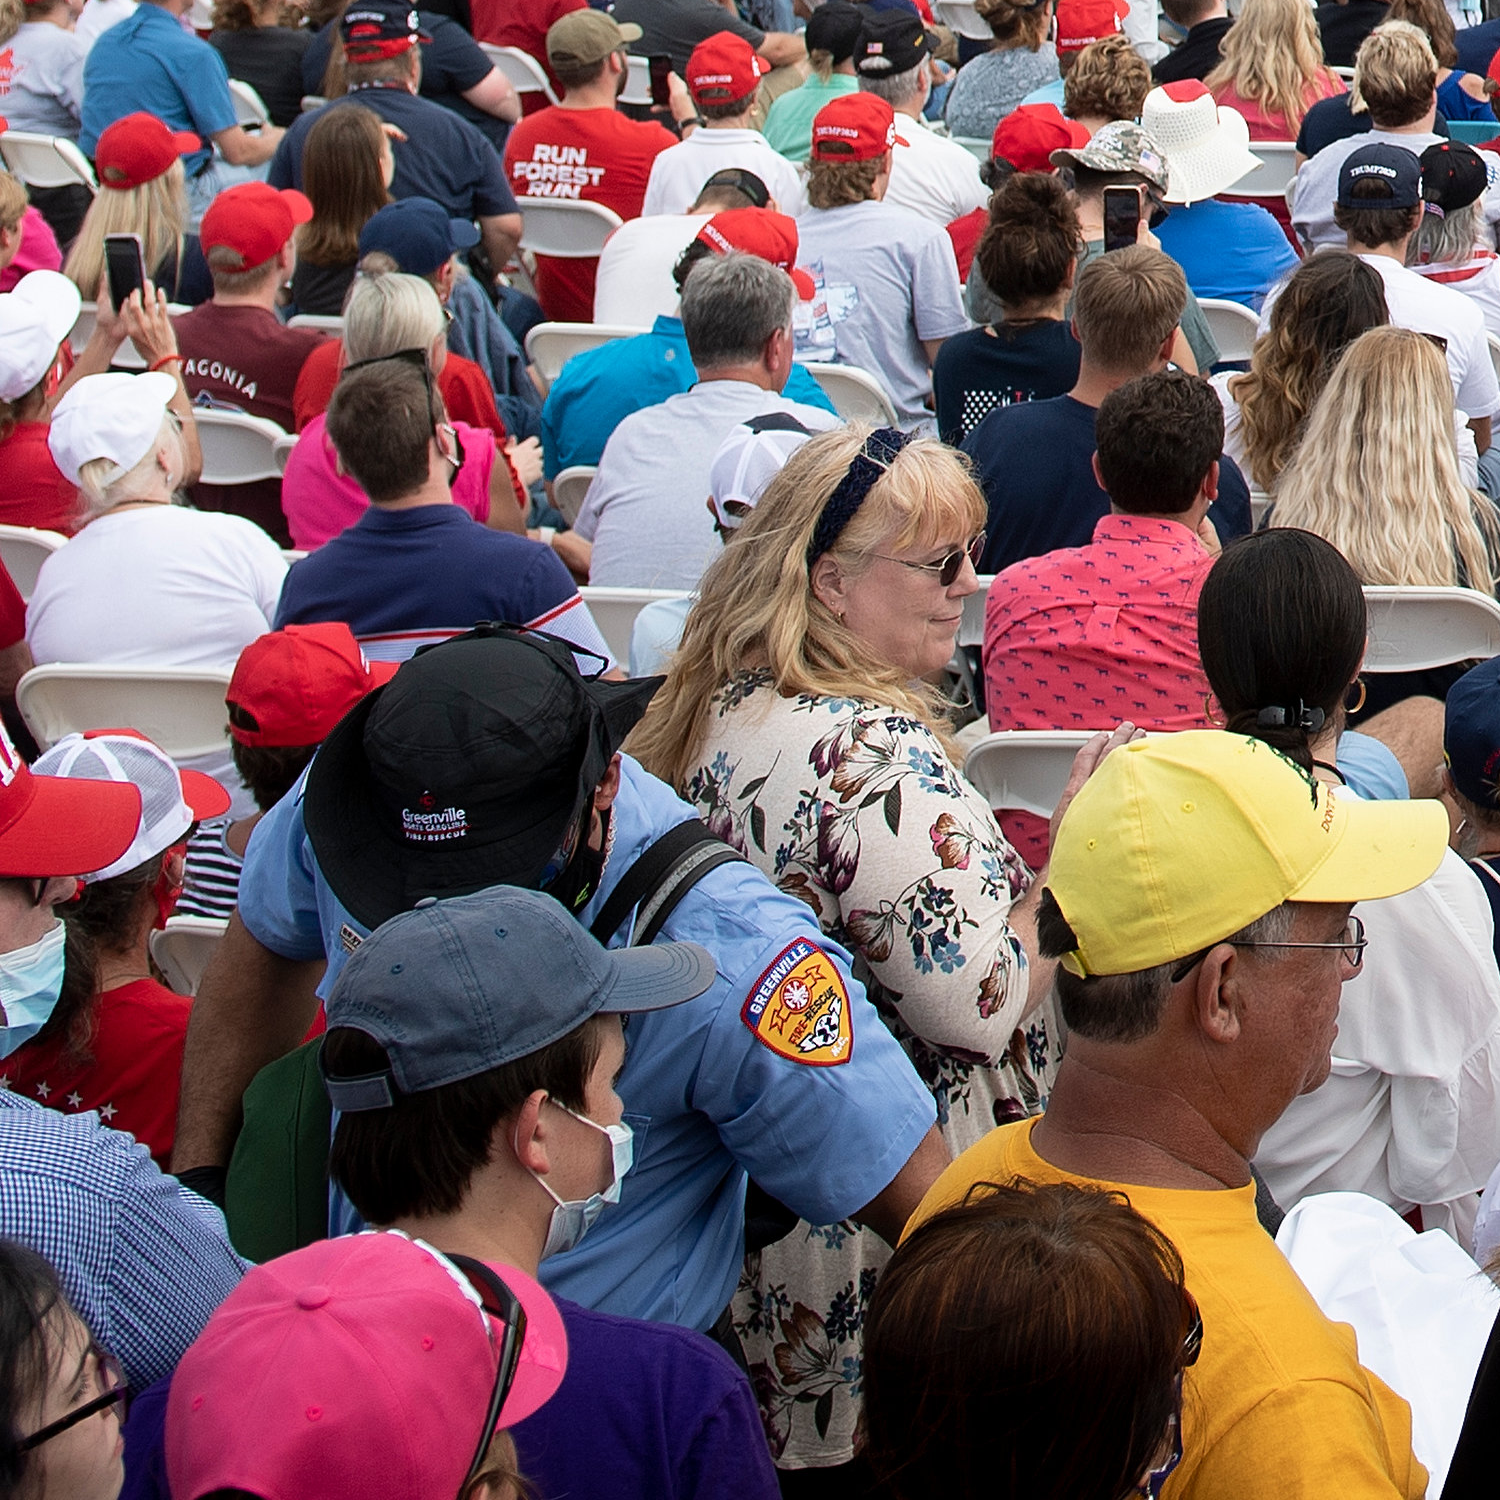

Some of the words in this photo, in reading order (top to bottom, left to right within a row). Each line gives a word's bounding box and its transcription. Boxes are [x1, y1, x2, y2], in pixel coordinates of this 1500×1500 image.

[532, 143, 588, 164] RUN
[512, 161, 606, 187] FOREST
[1350, 165, 1397, 178] TRUMP2020
[527, 181, 582, 199] RUN
[177, 358, 256, 400] AGONIA
[402, 807, 466, 824] Greenville
[425, 820, 468, 832] CAROLINA
[750, 944, 809, 1015] GREENVILLE
